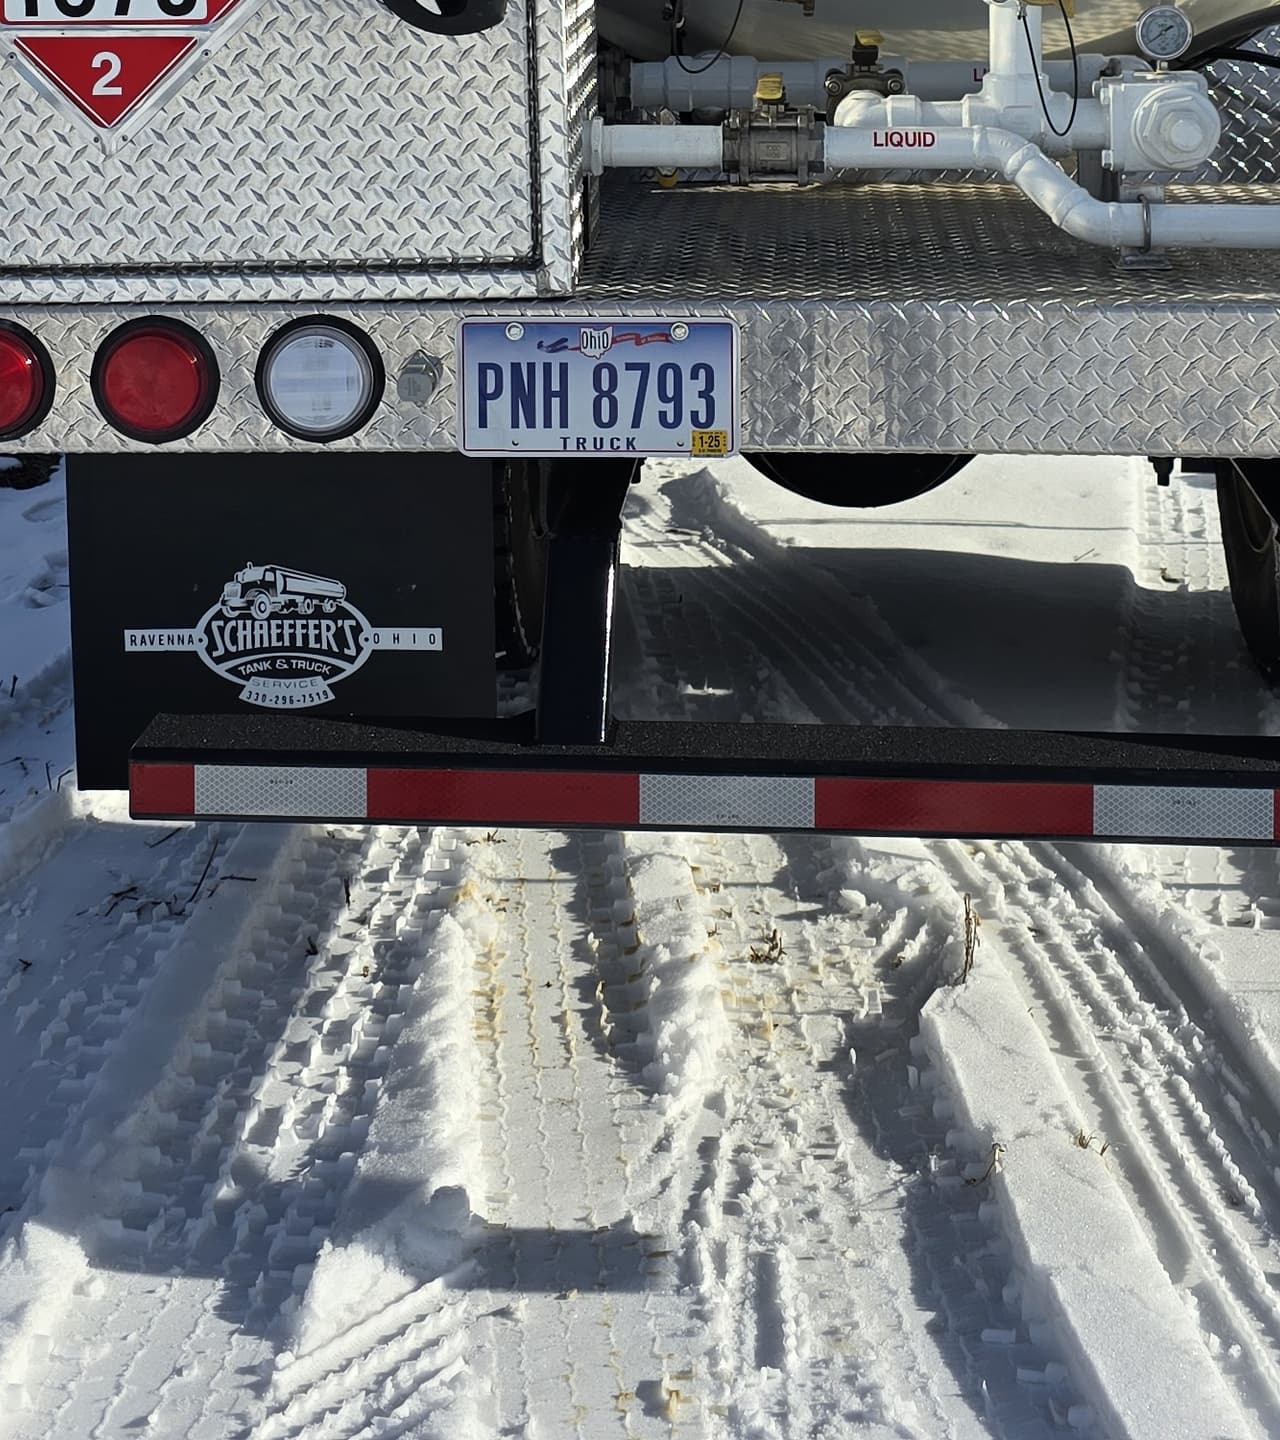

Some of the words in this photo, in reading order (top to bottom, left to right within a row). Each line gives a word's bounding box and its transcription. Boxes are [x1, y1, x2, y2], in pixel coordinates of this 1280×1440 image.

[91, 51, 123, 96] 2
[873, 131, 936, 148] LIQUID
[478, 362, 569, 429] PNH
[592, 362, 716, 429] 8793
[560, 436, 638, 451] TRUCK
[129, 634, 195, 647] RAVENNA
[211, 618, 357, 658] SCHAEFFER'S
[373, 632, 437, 646] OHIO
[238, 659, 273, 676] TANK
[276, 659, 289, 670] &
[292, 659, 332, 676] TRUCK
[251, 677, 320, 690] SERVICE
[246, 689, 330, 706] 330-296-7519
